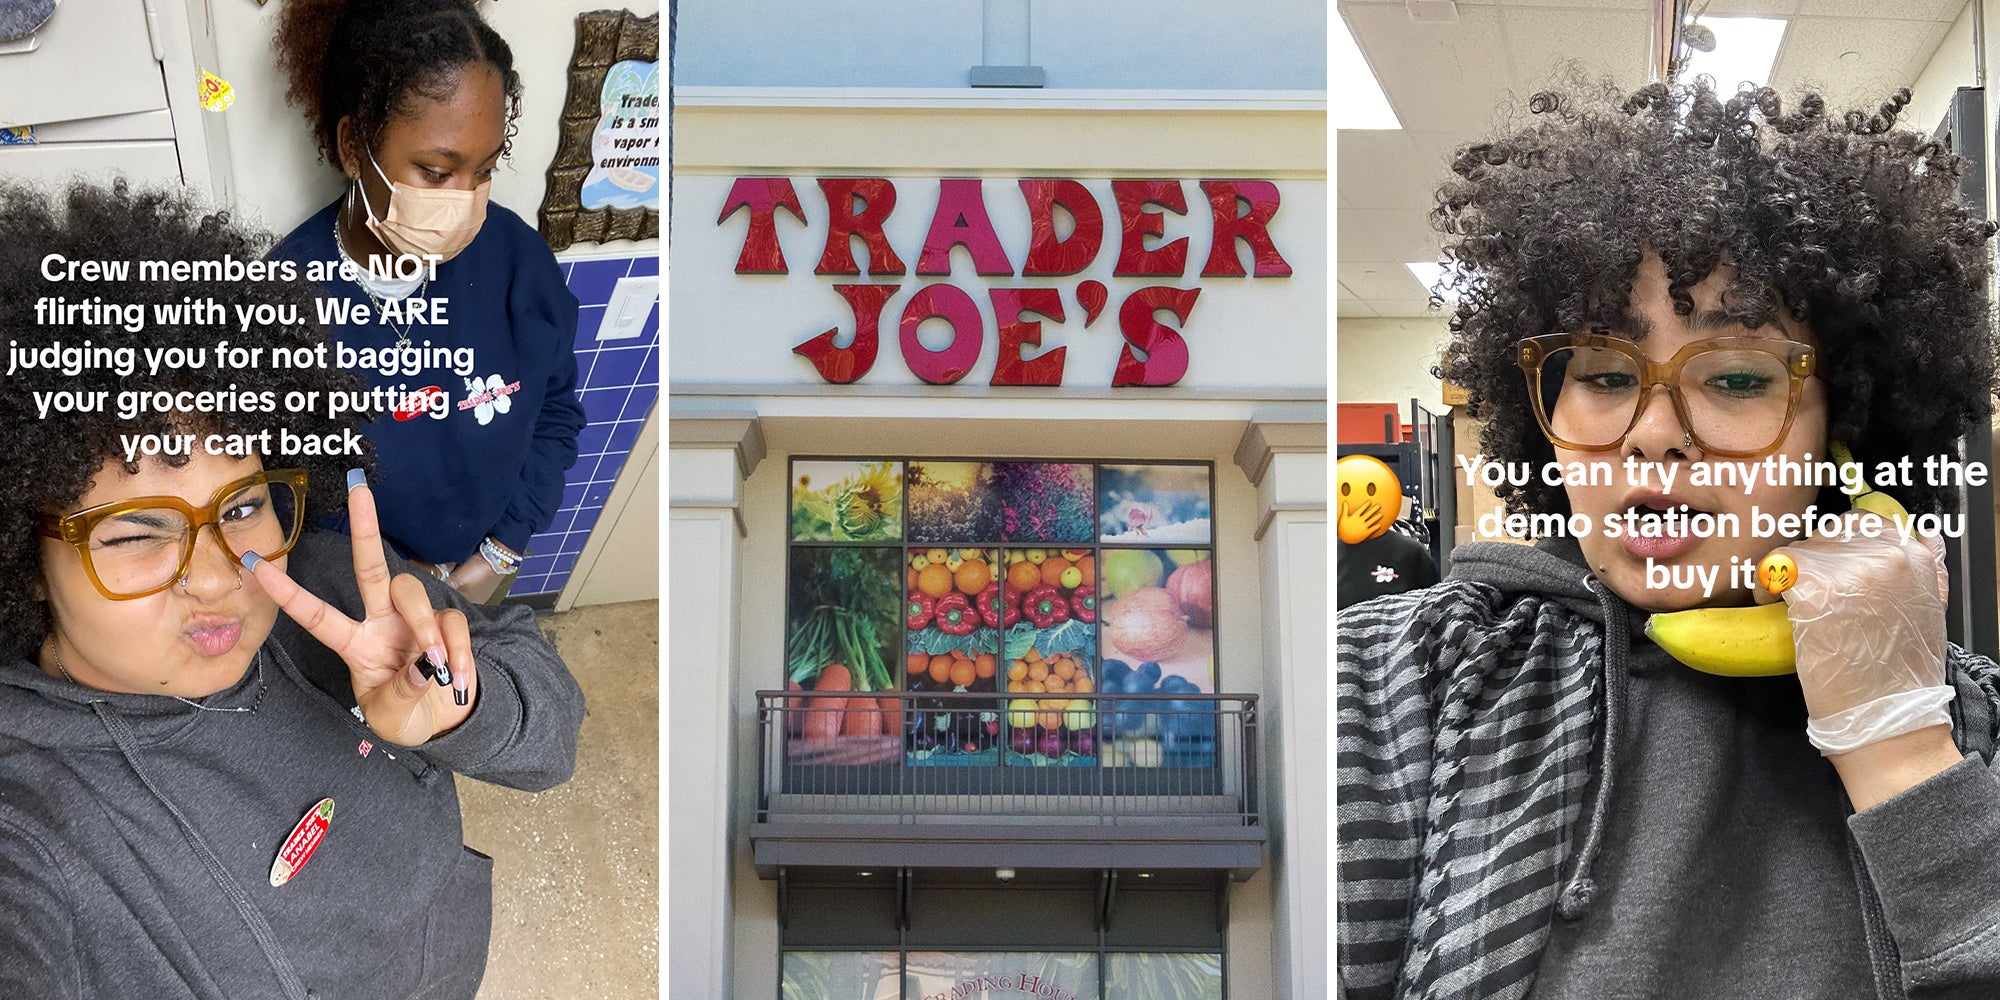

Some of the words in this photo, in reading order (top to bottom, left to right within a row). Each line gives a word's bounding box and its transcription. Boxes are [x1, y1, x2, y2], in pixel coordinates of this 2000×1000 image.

[621, 93, 659, 108] Trade
[611, 115, 624, 129] is
[627, 117, 636, 129] a
[614, 137, 652, 151] vapor
[717, 178, 1293, 278] TRADER
[791, 279, 1202, 388] JOE'S
[290, 823, 320, 864] ANABEL
